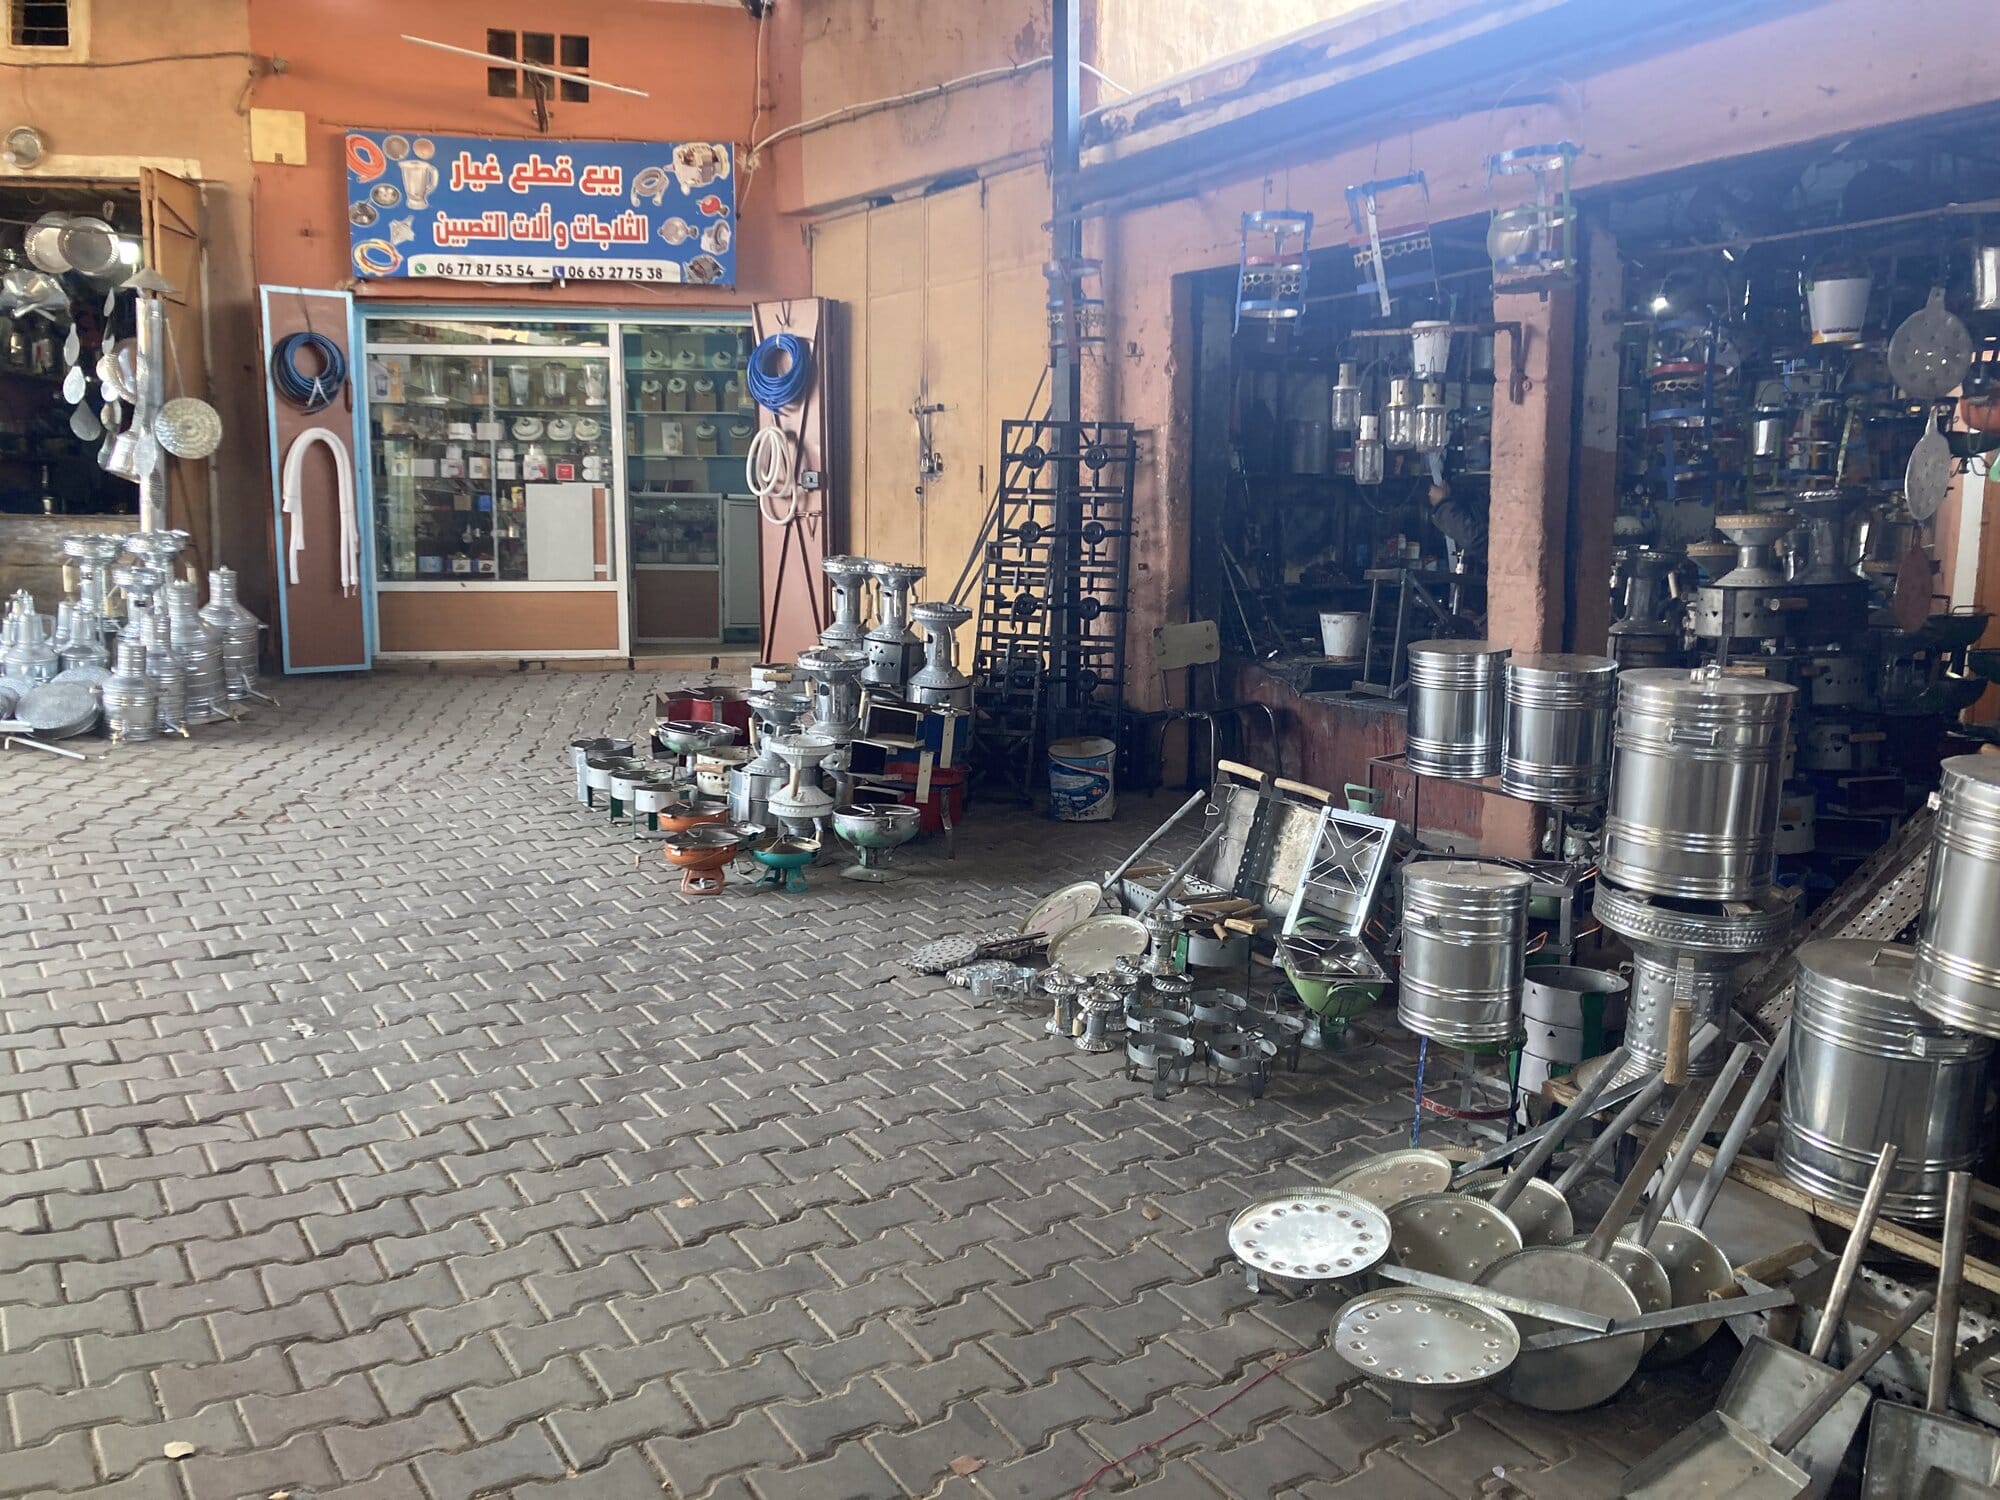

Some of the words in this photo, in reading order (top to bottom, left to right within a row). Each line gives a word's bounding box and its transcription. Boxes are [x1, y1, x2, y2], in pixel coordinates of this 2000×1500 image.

[450, 151, 503, 192] غيار
[509, 154, 574, 193] قطع
[580, 165, 622, 197] بيع
[433, 211, 508, 247] التصبين
[511, 202, 551, 241] ألات
[553, 220, 569, 250] و
[570, 209, 649, 250] الثلاجات
[437, 262, 453, 275] 06
[457, 263, 471, 275] 77
[476, 263, 491, 276] 87
[496, 264, 512, 277] 53
[516, 264, 534, 278] 54
[568, 266, 584, 277] 06
[588, 266, 605, 278] 63
[608, 267, 623, 279] 27
[627, 267, 643, 280] 75
[646, 267, 663, 280] 38
